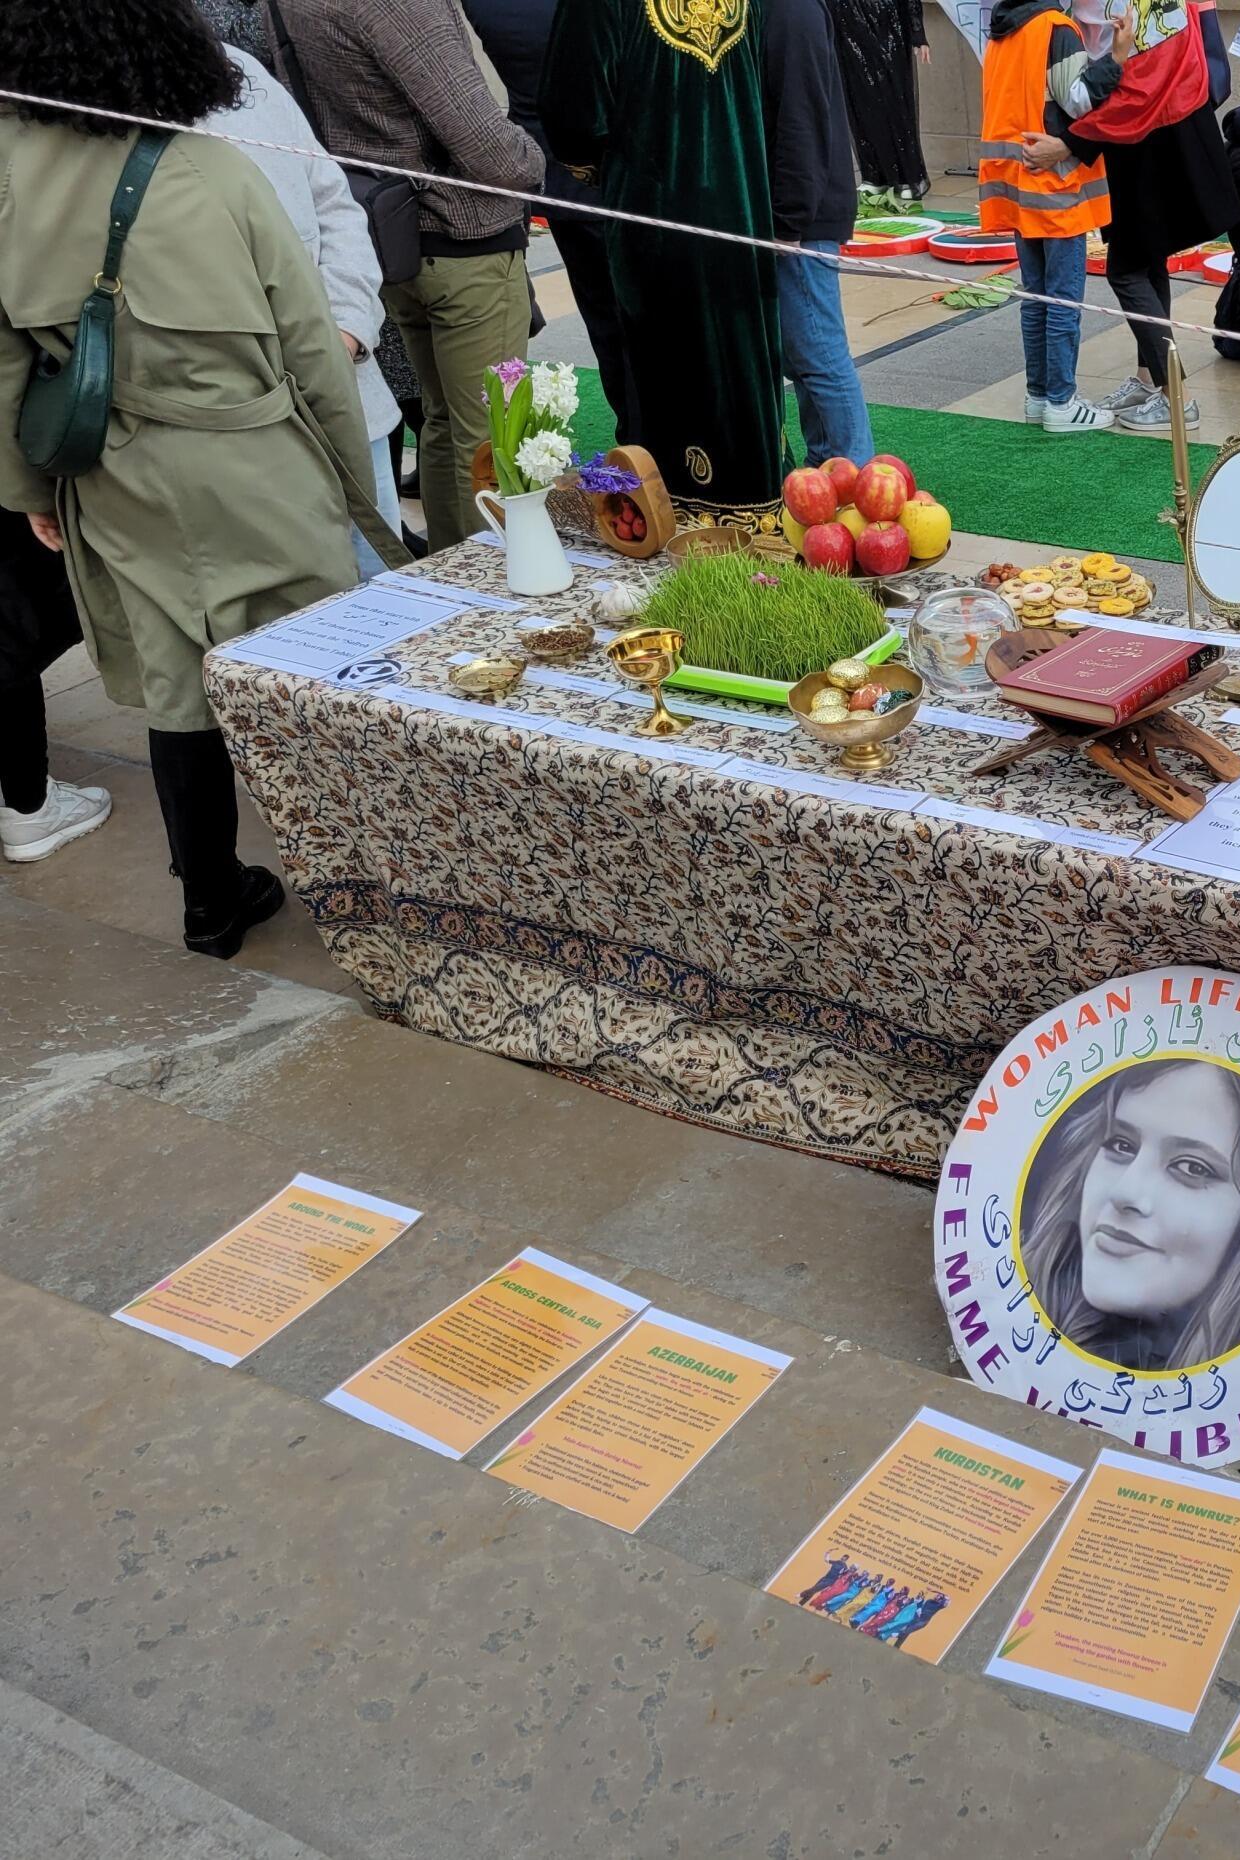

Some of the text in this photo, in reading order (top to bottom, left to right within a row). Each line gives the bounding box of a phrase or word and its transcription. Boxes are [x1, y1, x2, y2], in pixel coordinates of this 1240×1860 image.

[1208, 821, 1231, 830] they
[963, 986, 1132, 1134] WOMAN
[287, 1201, 375, 1234] AROUND THE WORLD
[942, 1162, 1011, 1385] FEMME
[500, 1280, 602, 1329] ACROSS CENTRAL ASIA
[647, 1346, 737, 1383] AZERBAIJAN
[1064, 1364, 1228, 1415] زندگی
[934, 1447, 1024, 1490] KURDISTAN
[1117, 1487, 1158, 1504] WHAT
[1159, 1498, 1174, 1508] IS
[1176, 1502, 1240, 1525] NOWRUZ?
